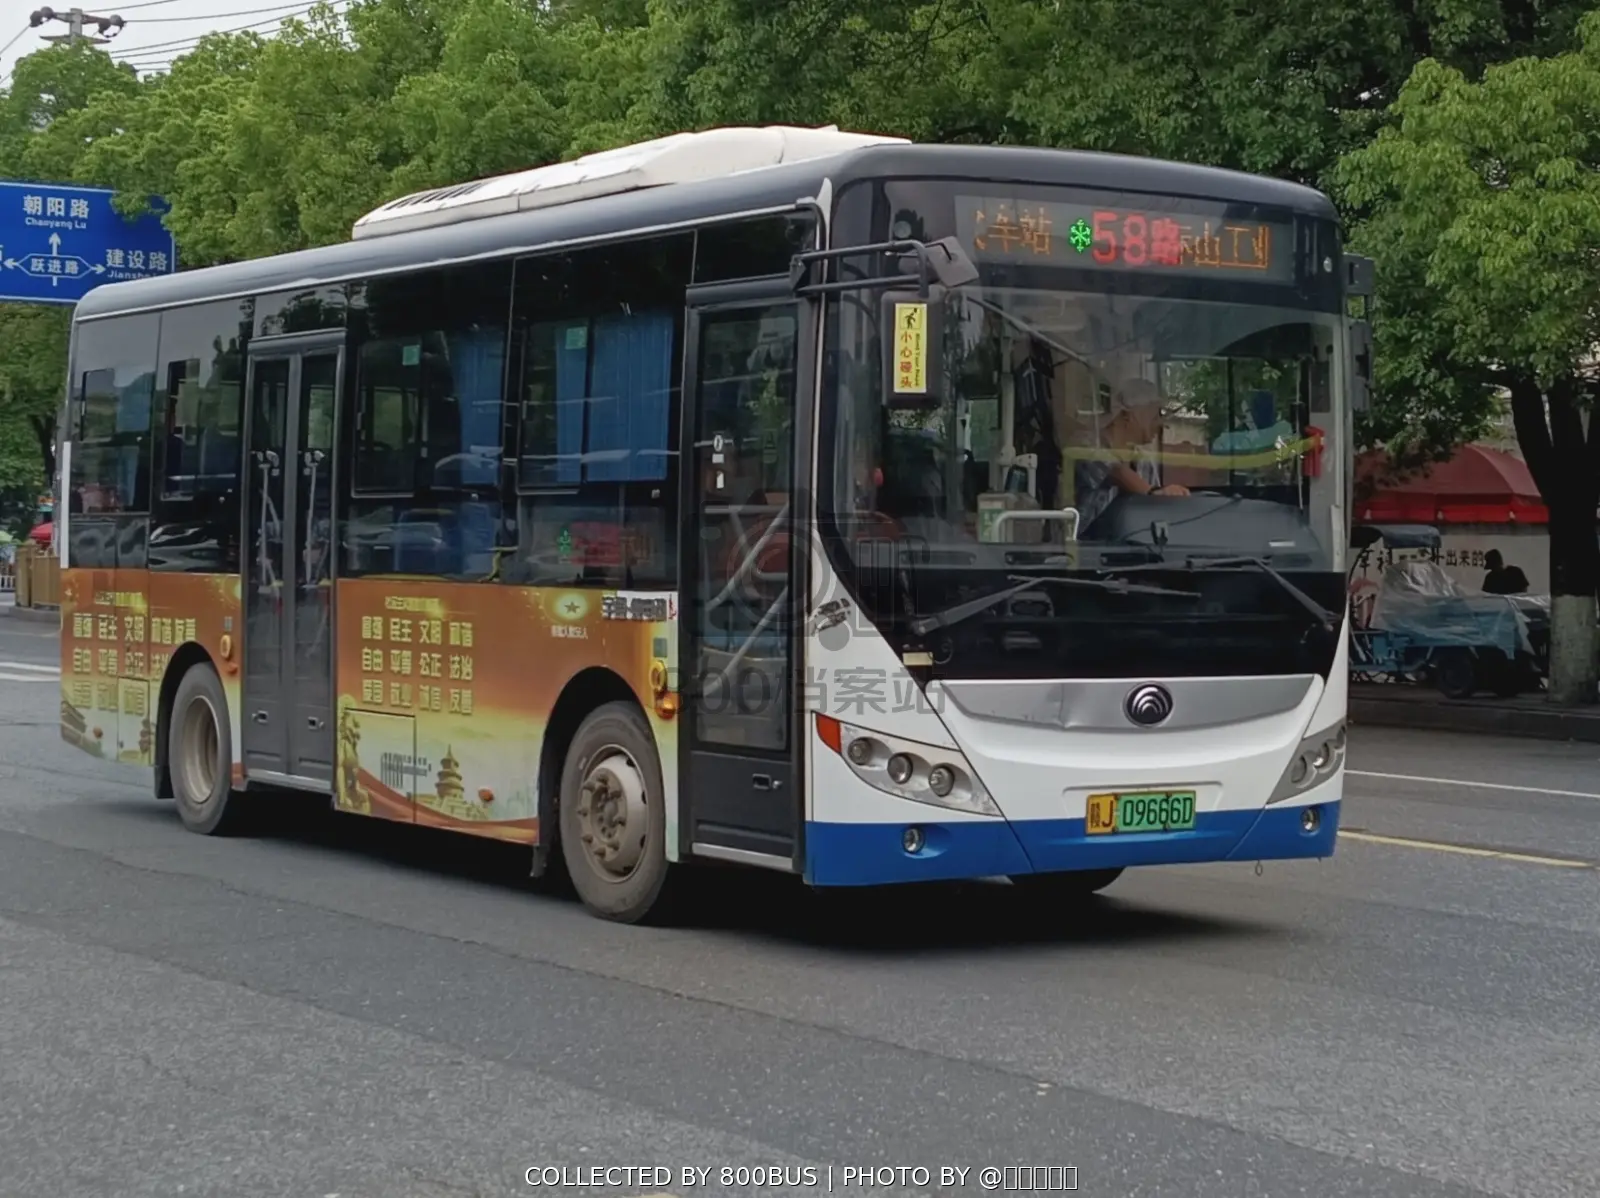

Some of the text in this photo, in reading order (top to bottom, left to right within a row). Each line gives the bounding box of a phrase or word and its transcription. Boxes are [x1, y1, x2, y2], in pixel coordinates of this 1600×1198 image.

[23, 195, 90, 219] 朝阳路
[25, 217, 87, 230] Chaoyang Lu
[976, 205, 1053, 255] 车站
[30, 258, 79, 276] 跃进路
[106, 249, 168, 271] 建设路
